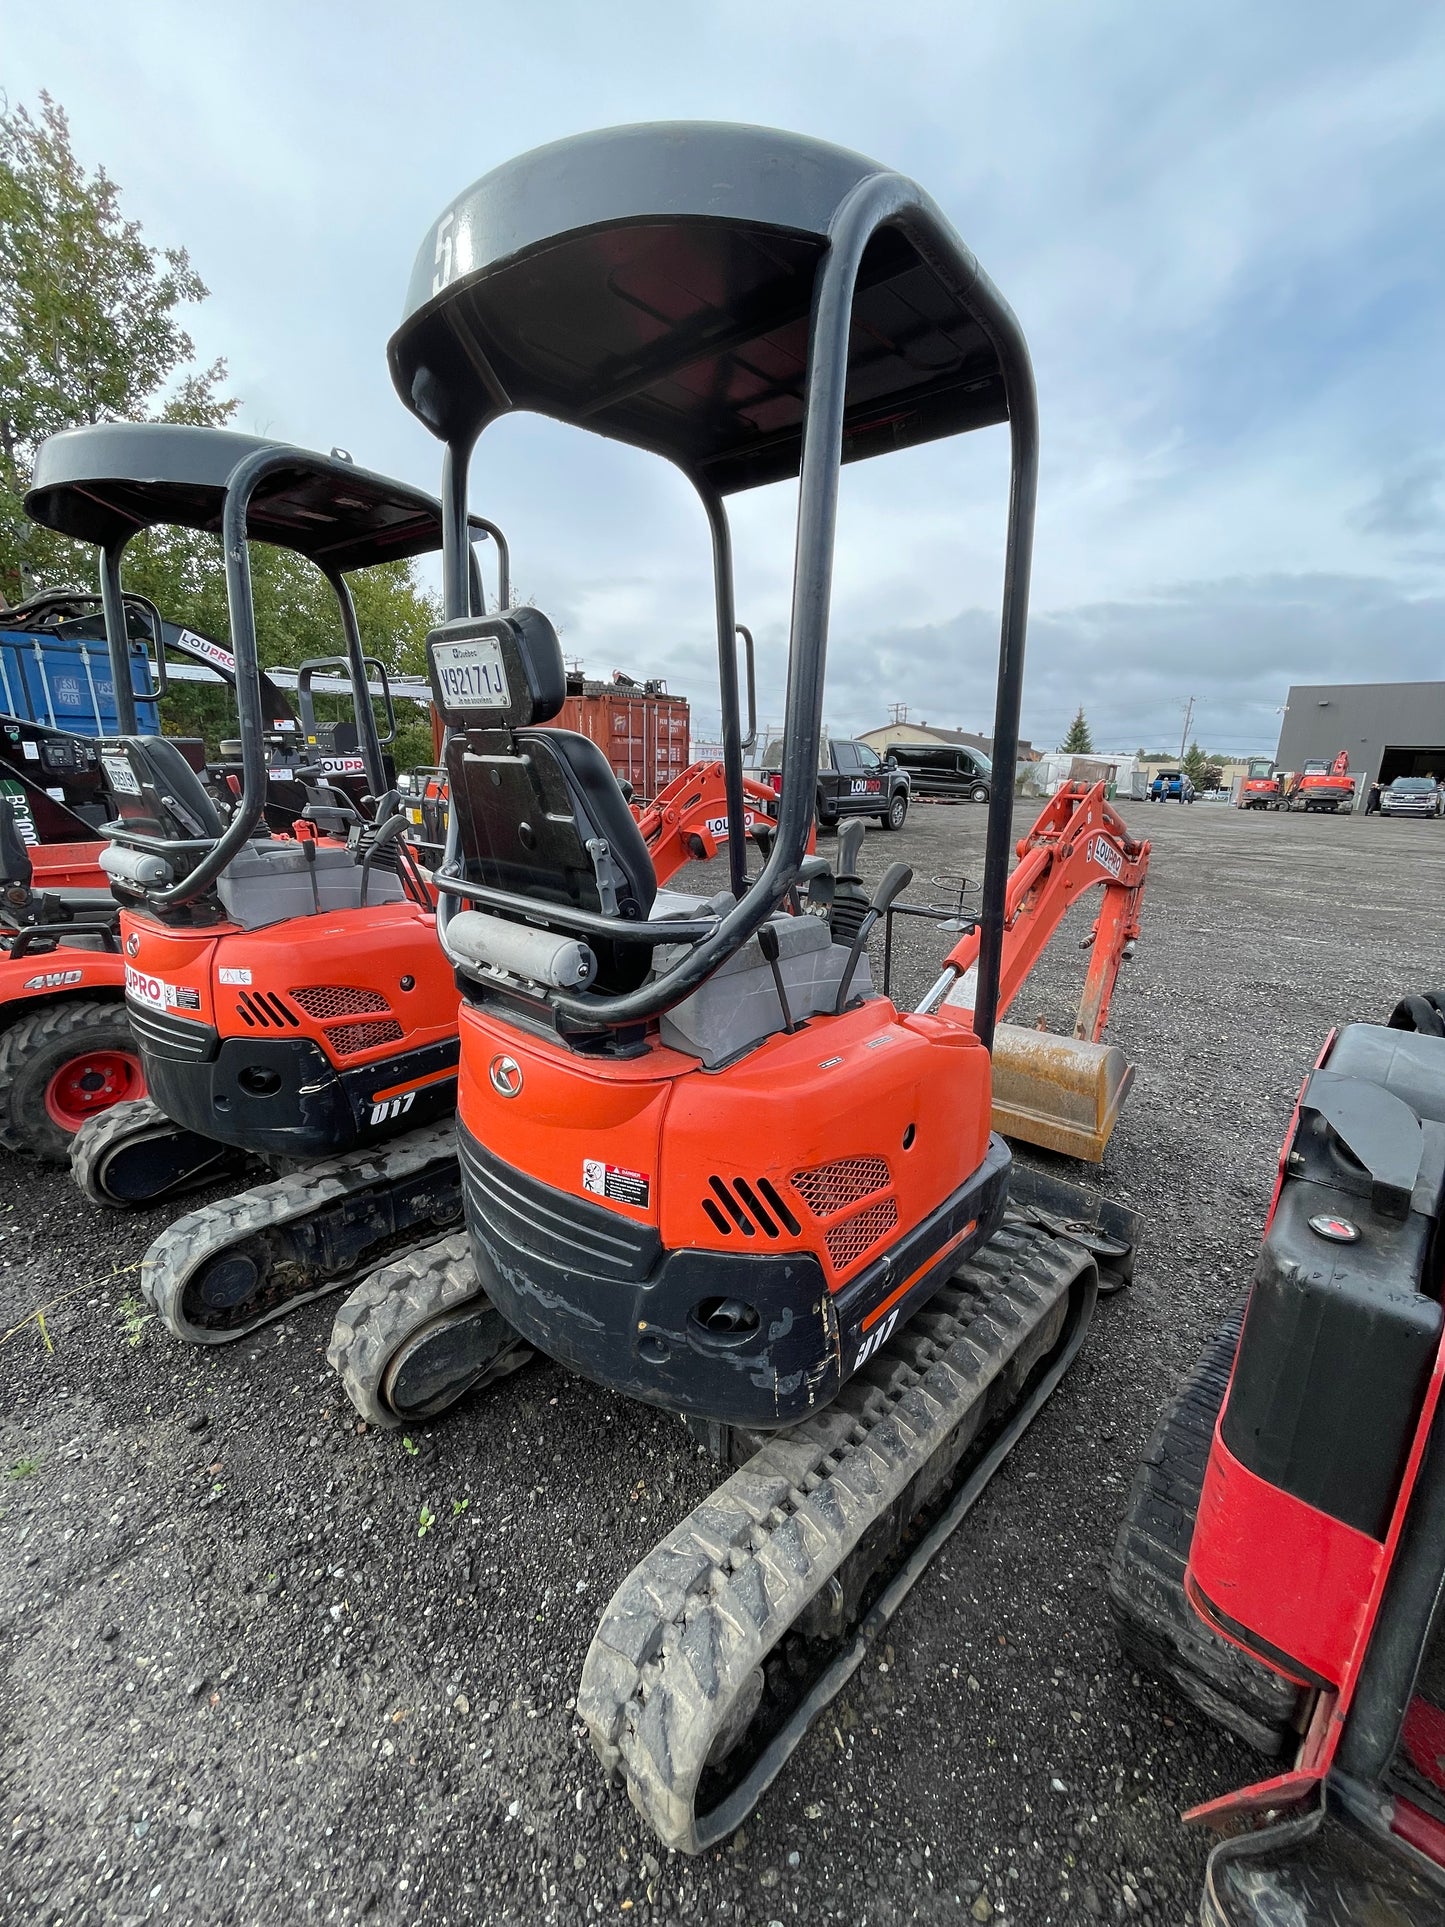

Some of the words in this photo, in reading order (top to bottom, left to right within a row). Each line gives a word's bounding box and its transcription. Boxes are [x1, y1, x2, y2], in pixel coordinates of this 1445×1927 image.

[181, 633, 235, 666] LOUPRO
[440, 663, 503, 696] V92171J
[323, 761, 363, 771] OUPR
[851, 780, 880, 792] LOUPRO
[708, 815, 752, 832] LOUO
[1096, 838, 1121, 871] LOUPRO
[23, 969, 83, 989] 4WD
[126, 967, 160, 1000] UPRO
